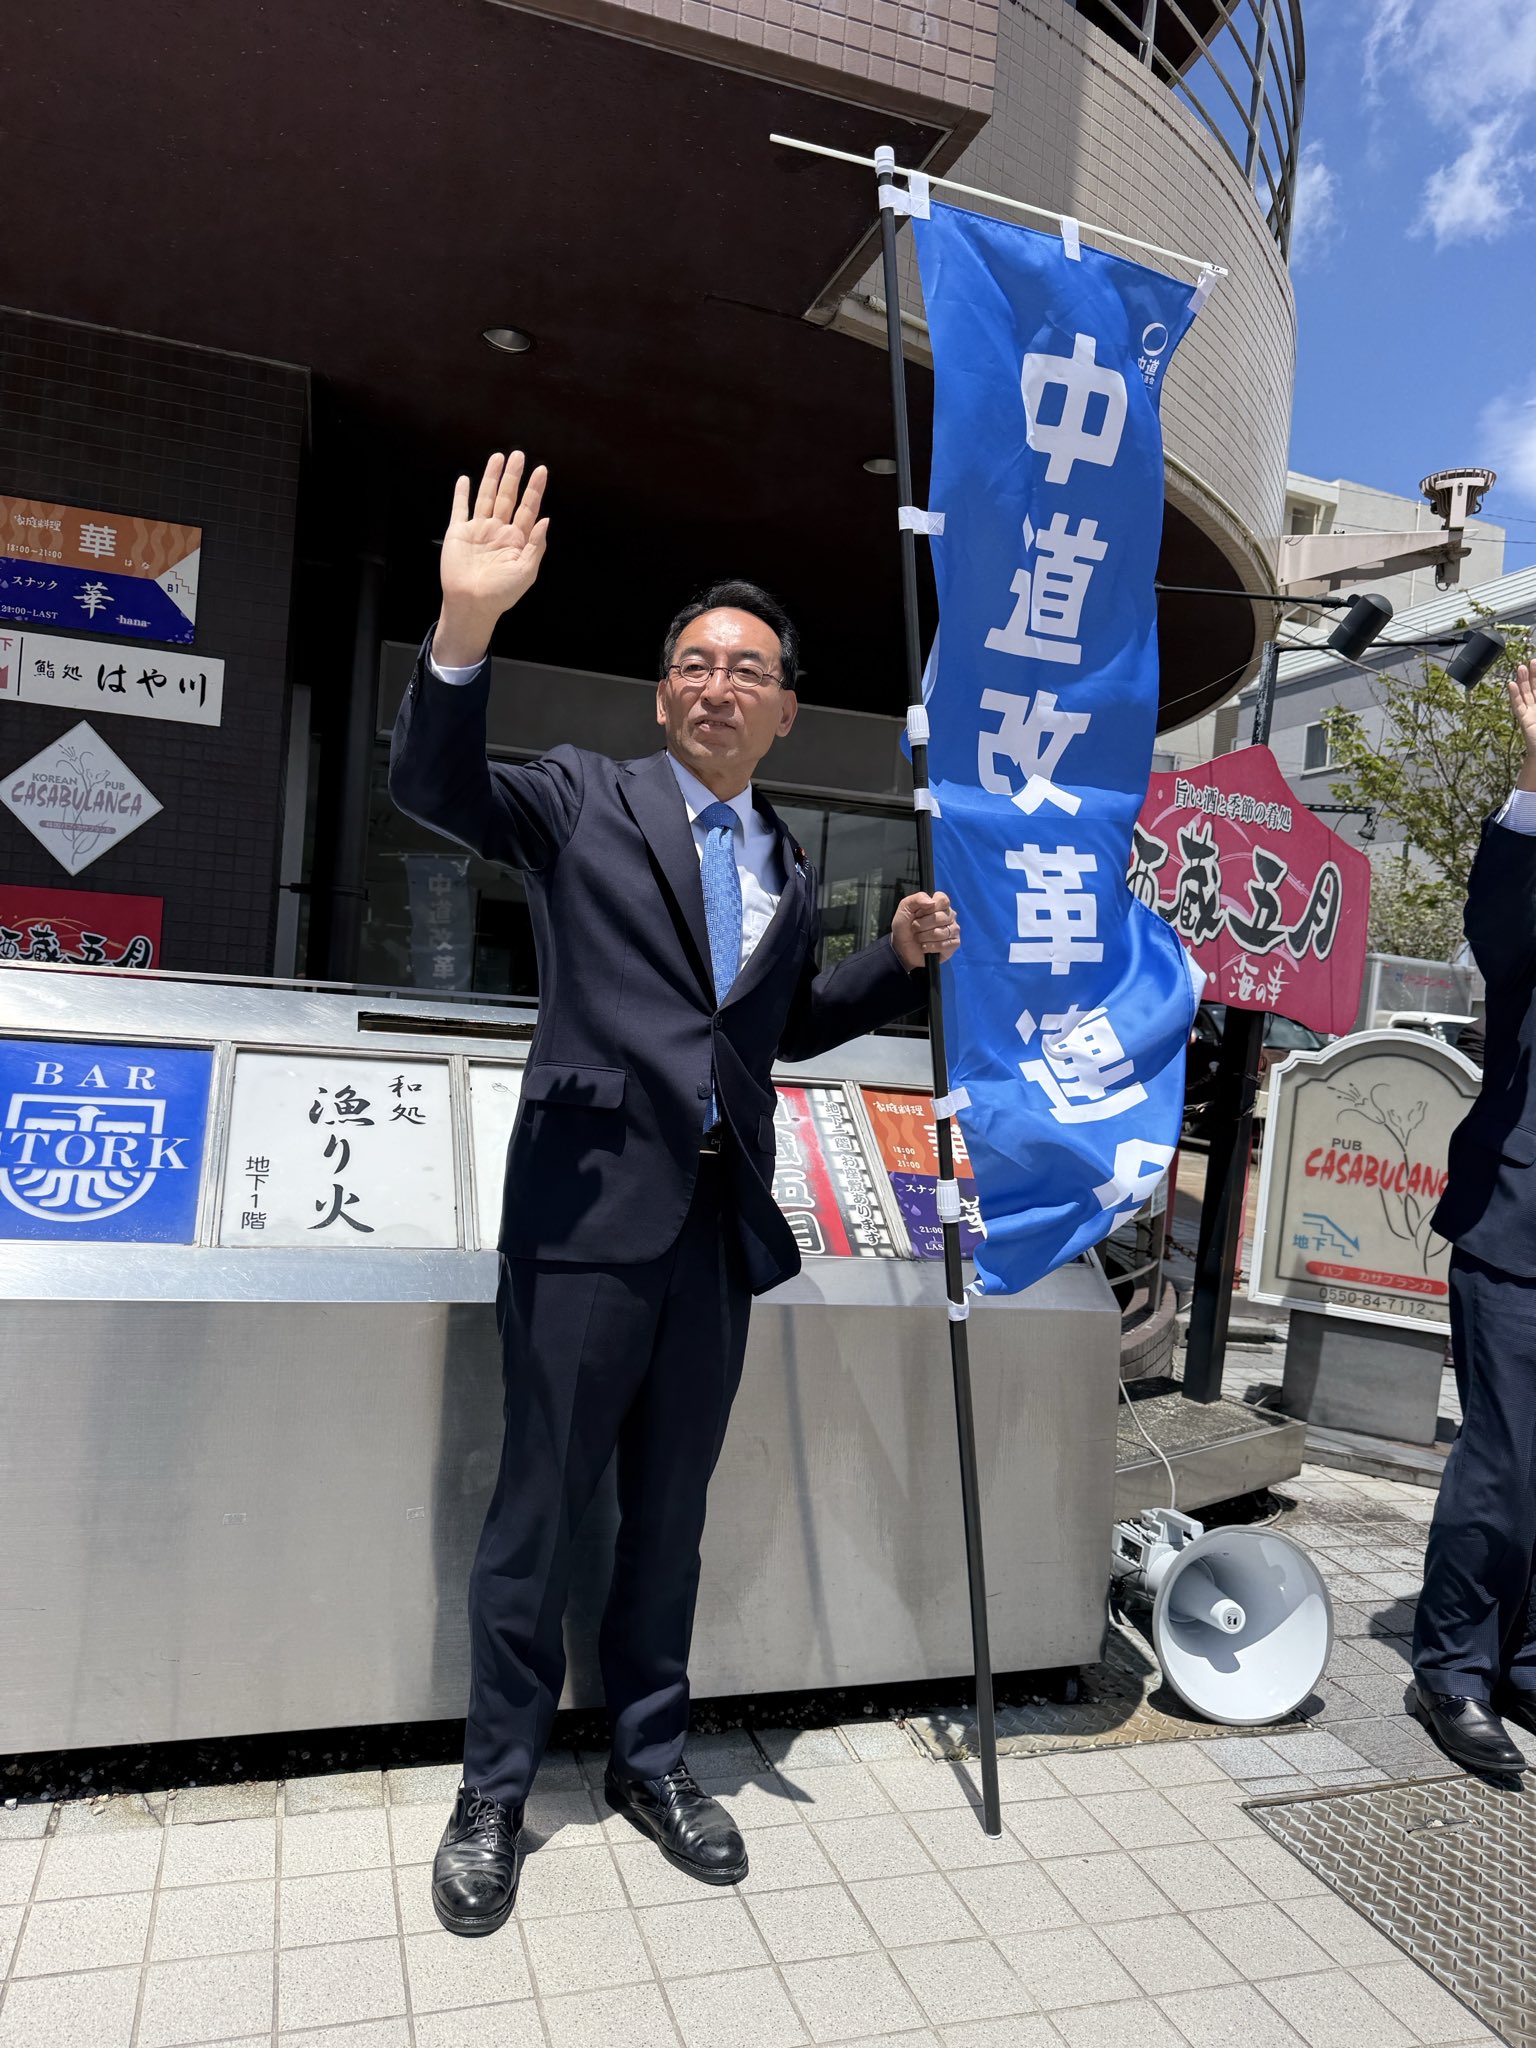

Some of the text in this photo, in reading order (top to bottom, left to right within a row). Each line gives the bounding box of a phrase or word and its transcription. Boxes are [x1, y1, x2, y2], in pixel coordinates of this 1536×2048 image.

[14, 514, 62, 532] 家庭料理
[78, 523, 118, 558] 華
[12, 576, 58, 590] スナック
[167, 583, 179, 594] B1
[97, 663, 208, 708] はや川
[32, 772, 126, 791] KOREAN PUB
[11, 779, 143, 818] CASABULANCA
[1175, 777, 1293, 833] 旨い酒と季節の肴処
[32, 1061, 157, 1090] BAR
[388, 1075, 426, 1125] 和処
[873, 1100, 926, 1117] 家庭料理
[0, 1131, 190, 1169] TORK
[893, 1146, 916, 1156] 18:00
[1332, 1137, 1363, 1151] PUB
[306, 1085, 375, 1233] 漁り火
[897, 1159, 921, 1170] 21:00
[241, 1156, 270, 1230] 地下1階
[905, 1184, 938, 1195] スナッ
[925, 1242, 944, 1251] LAS
[1292, 1234, 1326, 1253] 地下
[1319, 1287, 1427, 1315] 0550-84-7112
